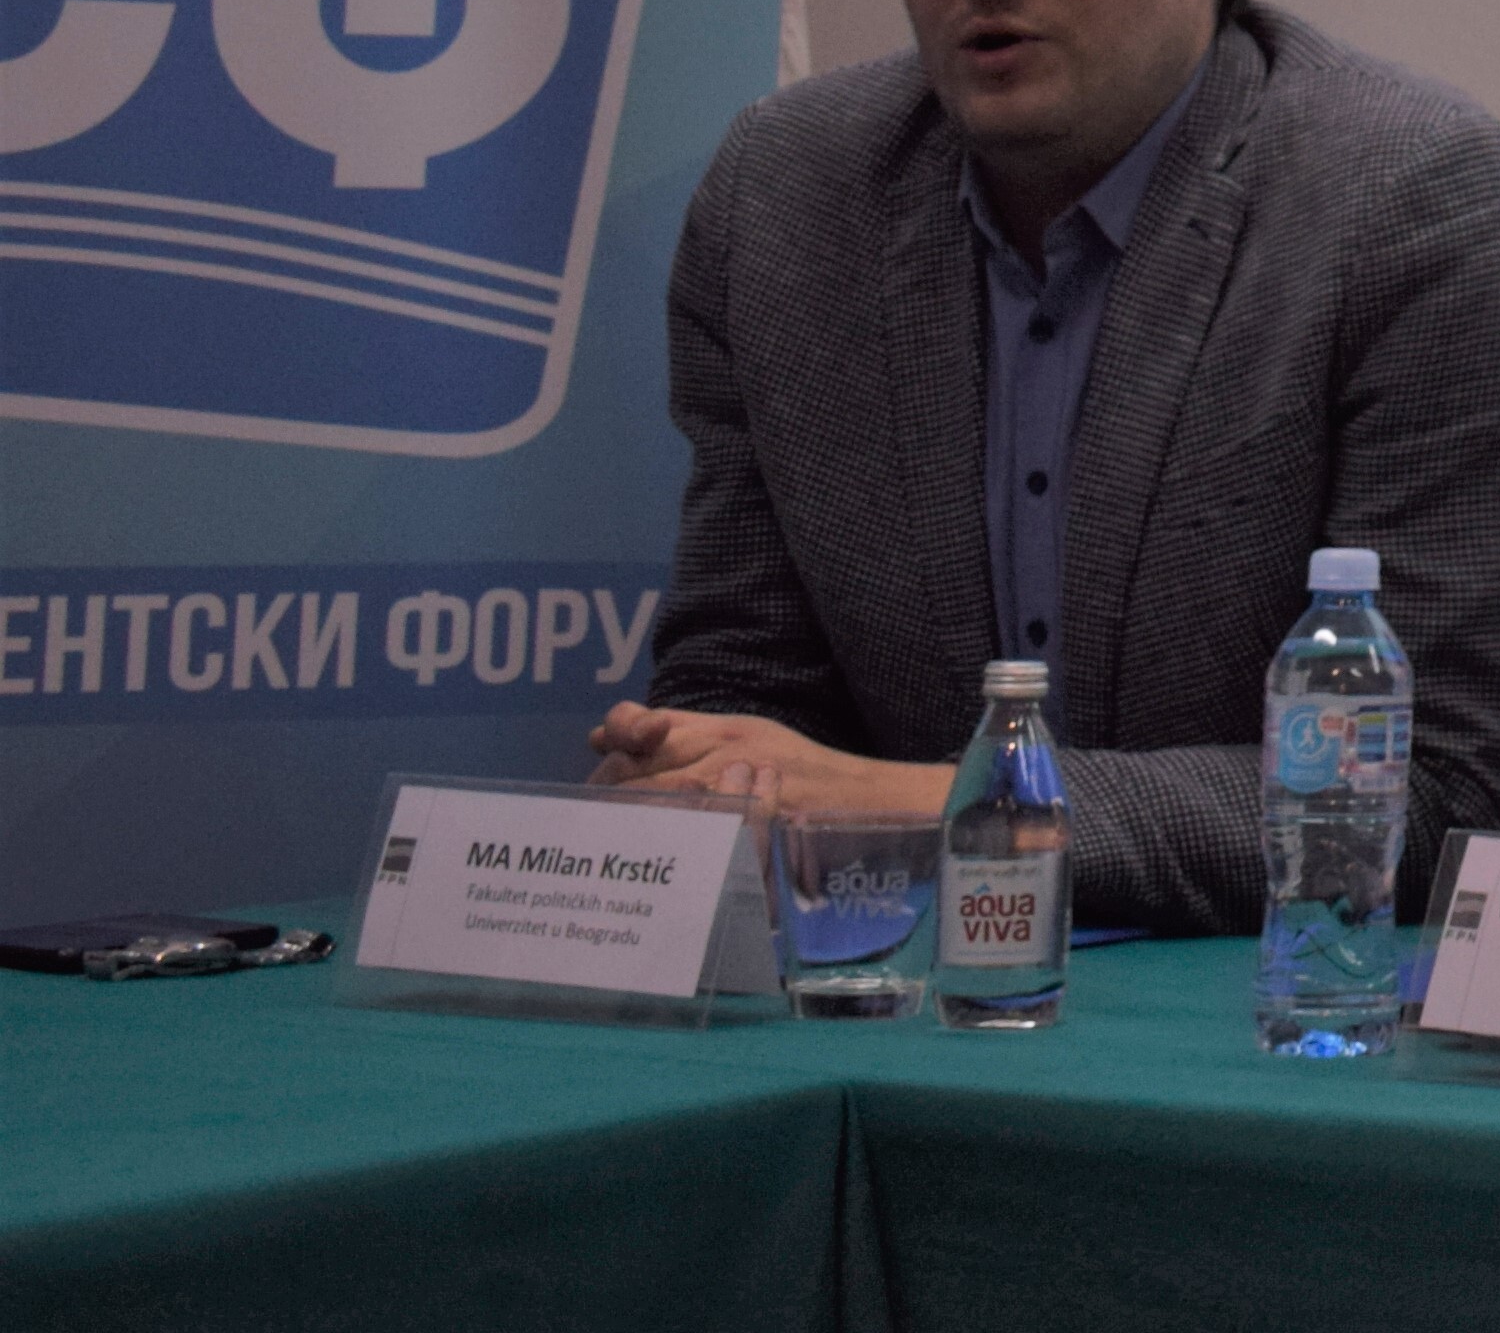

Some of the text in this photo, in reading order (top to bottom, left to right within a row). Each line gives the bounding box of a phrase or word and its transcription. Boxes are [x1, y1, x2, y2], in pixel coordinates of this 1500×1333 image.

[466, 841, 677, 886] MA Milan Krstić
[466, 883, 654, 918] Fakultet političkih nauka
[959, 890, 1036, 918] aqua
[464, 914, 641, 946] Univerzitet u Beogradu
[963, 919, 1032, 944] viva
